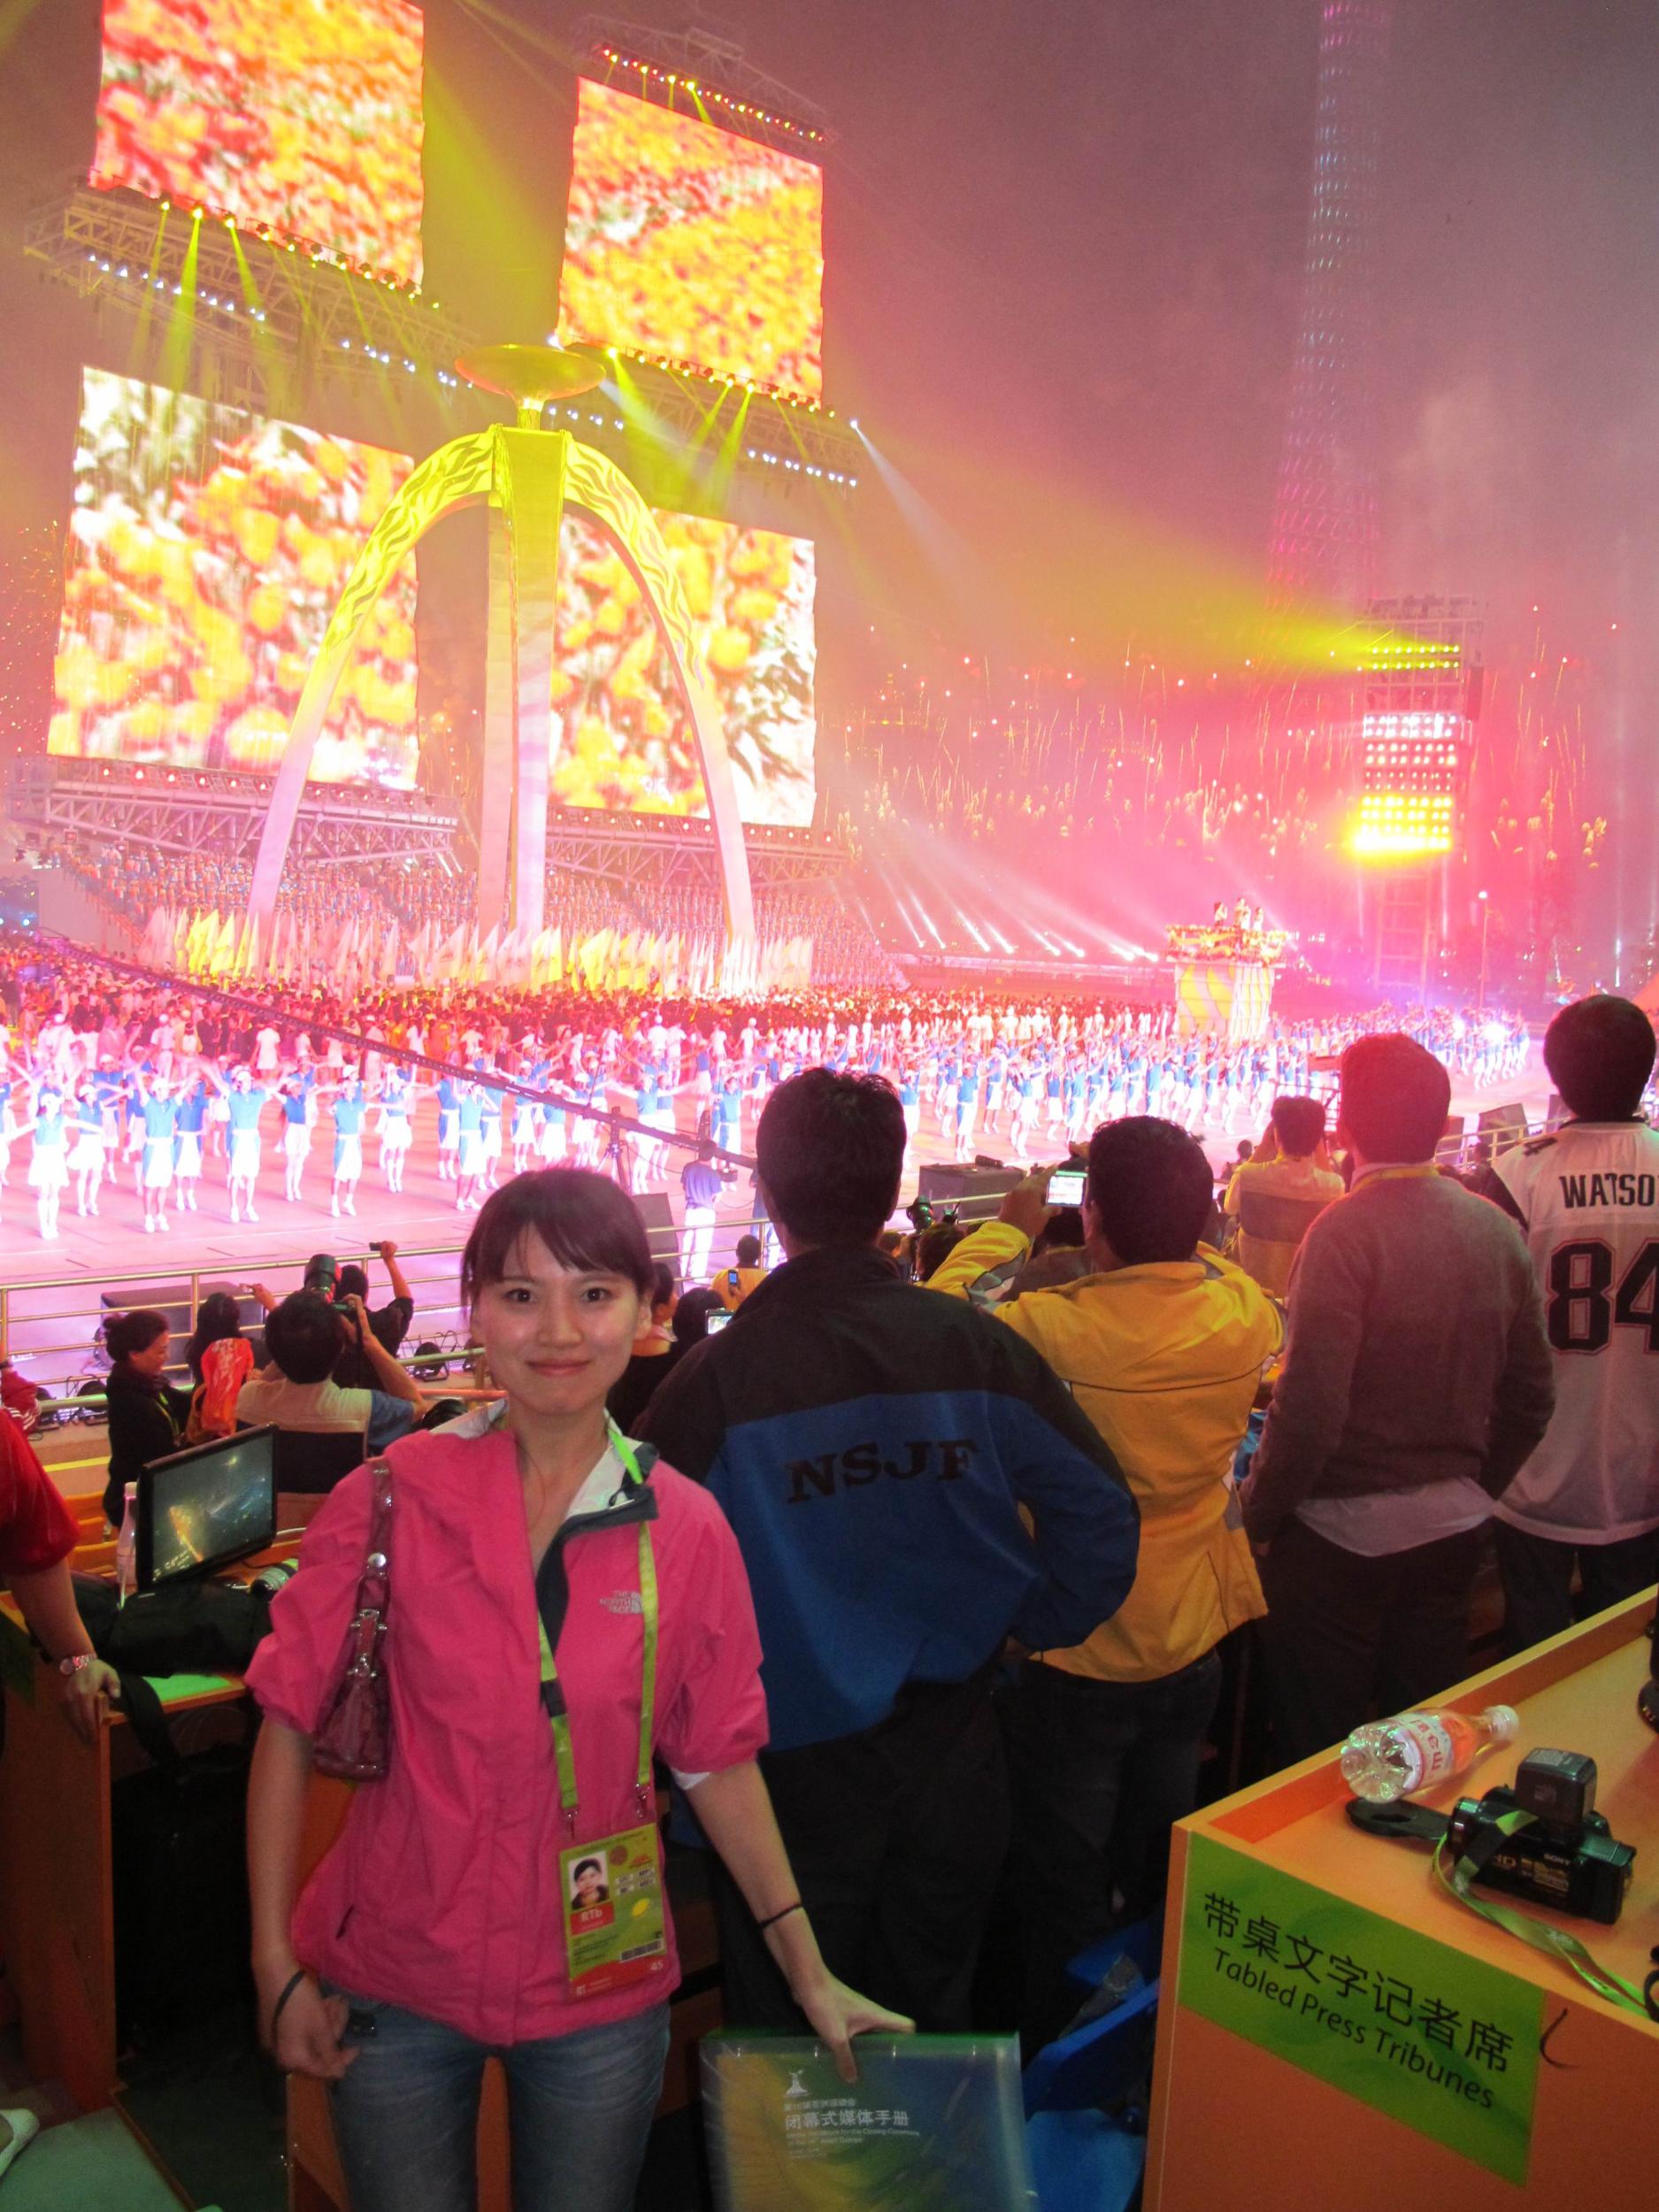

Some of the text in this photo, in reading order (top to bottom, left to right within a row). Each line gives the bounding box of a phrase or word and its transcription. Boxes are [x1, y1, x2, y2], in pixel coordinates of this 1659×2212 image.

[1559, 1172, 1659, 1209] WATSO
[1545, 1238, 1659, 1356] 84
[784, 1439, 979, 1504] NSJF
[1204, 1892, 1514, 2073] 带桌文字记者席
[1215, 1947, 1494, 2109] Tabled Press Tribunes
[786, 2109, 909, 2131] 闭幕式媒体手册
